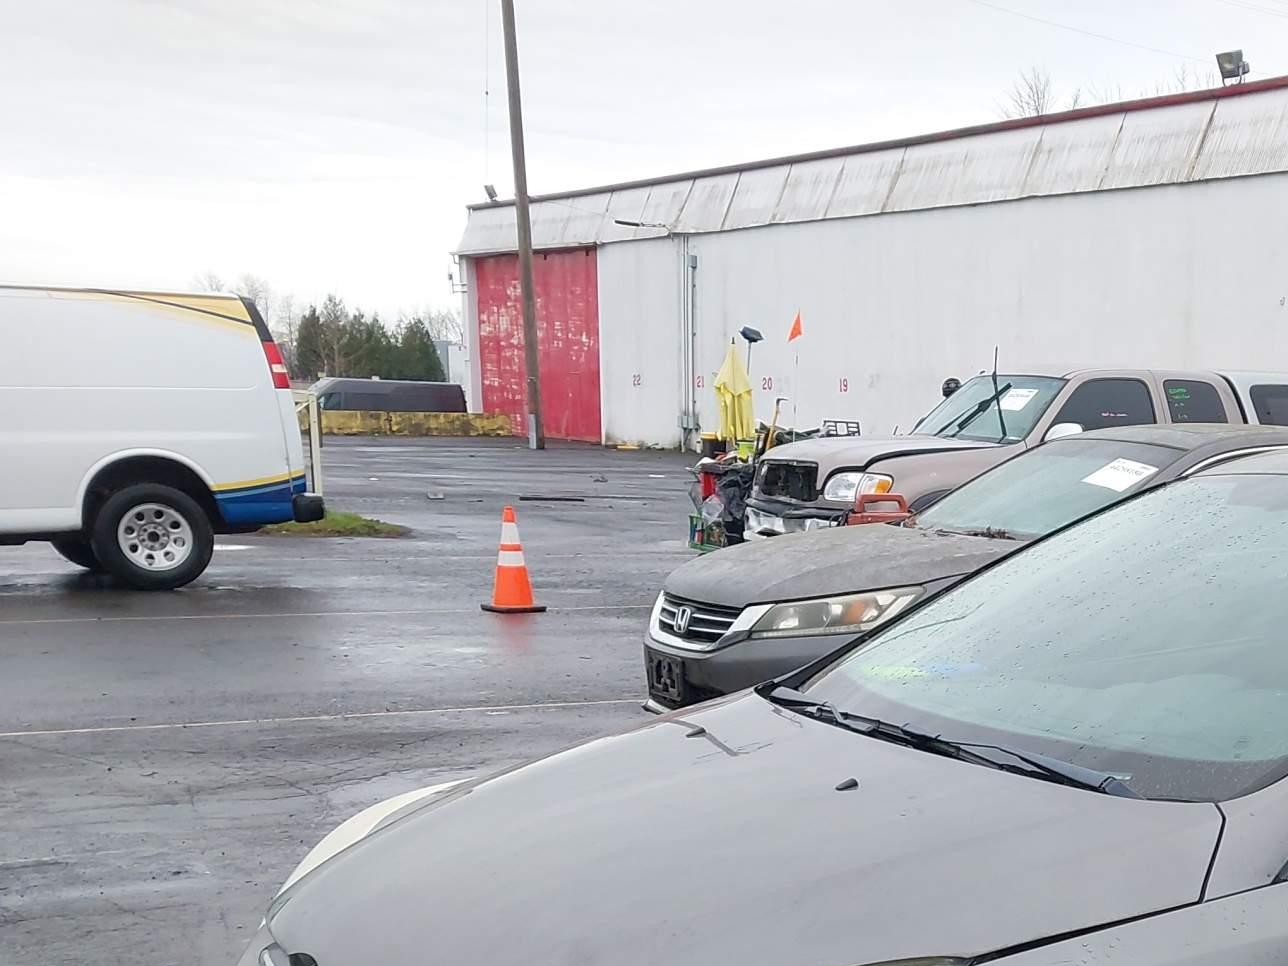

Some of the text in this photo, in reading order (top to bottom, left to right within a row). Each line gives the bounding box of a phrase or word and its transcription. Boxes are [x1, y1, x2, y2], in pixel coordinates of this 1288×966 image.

[696, 375, 705, 389] 21
[762, 377, 773, 391] 20
[839, 378, 848, 393] 19
